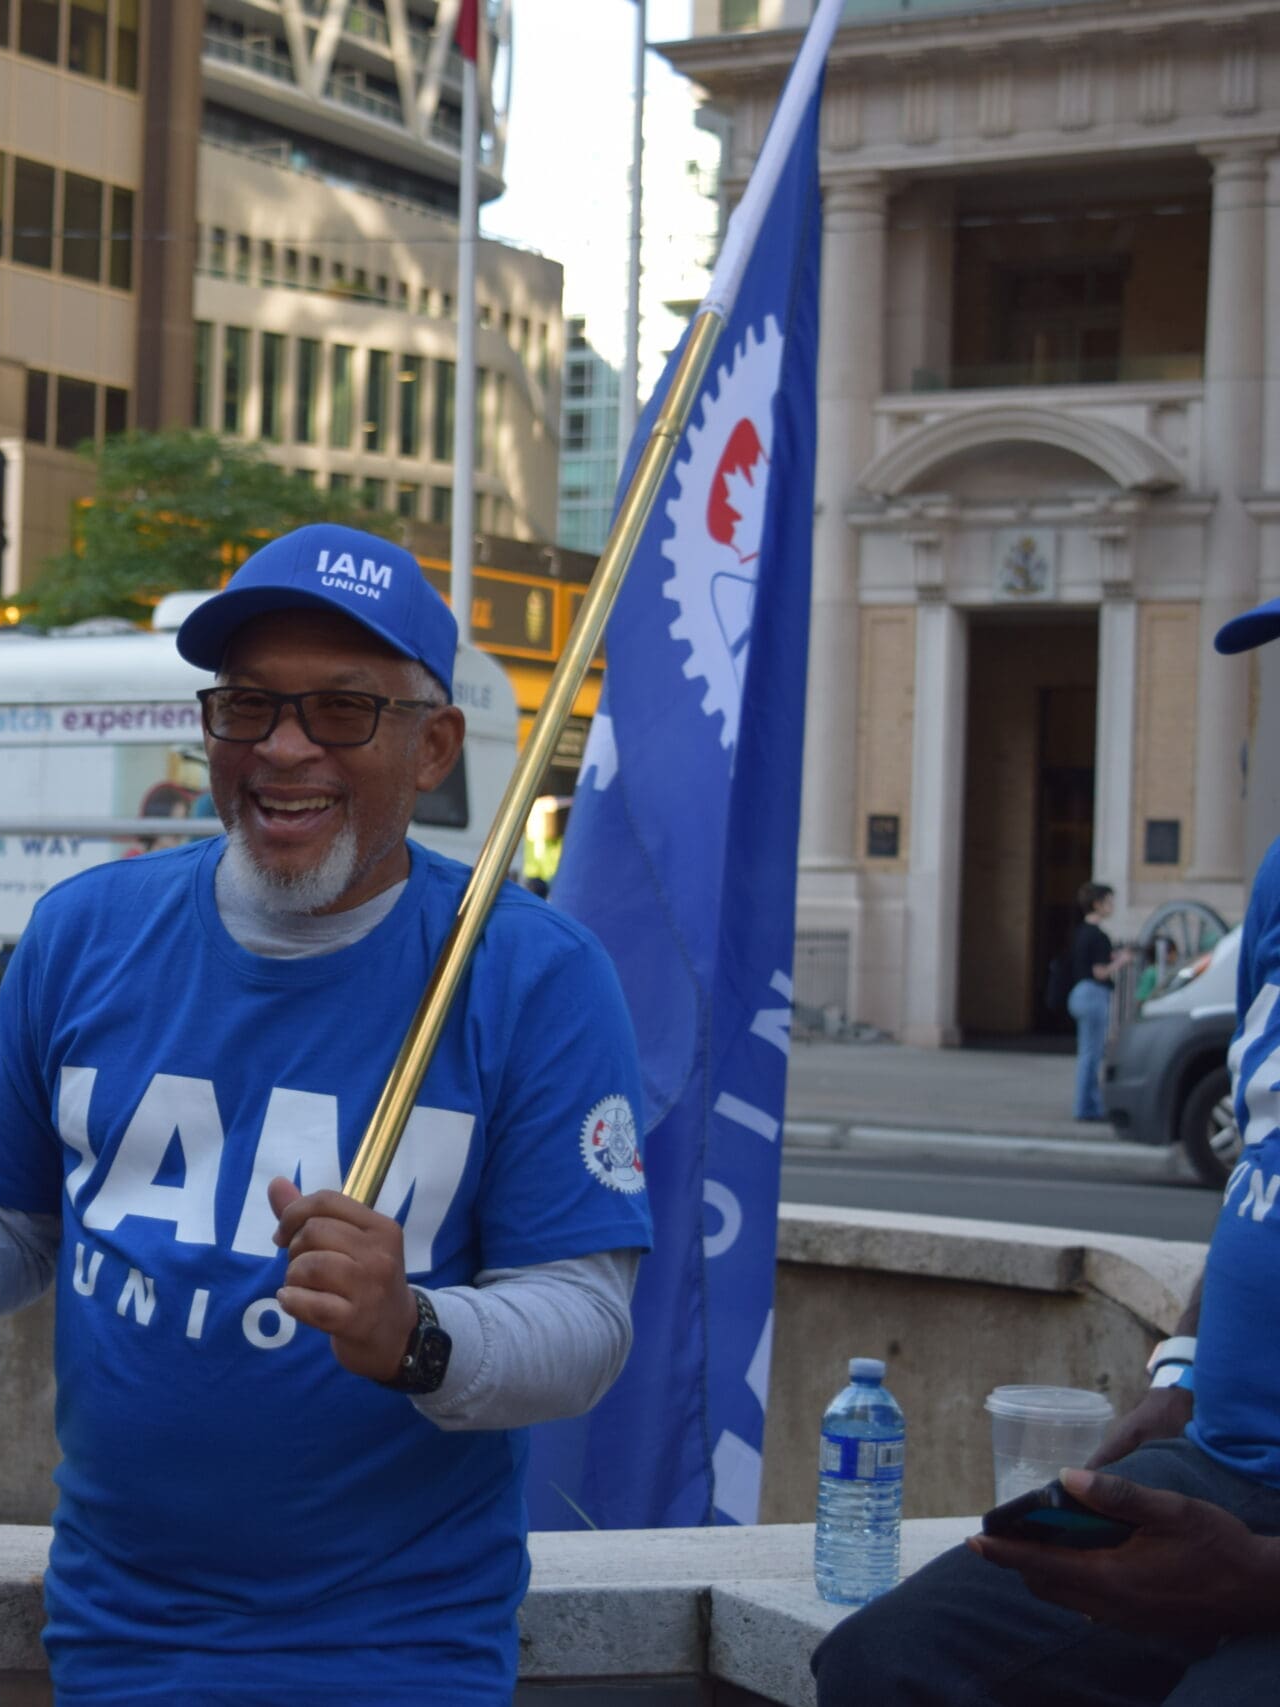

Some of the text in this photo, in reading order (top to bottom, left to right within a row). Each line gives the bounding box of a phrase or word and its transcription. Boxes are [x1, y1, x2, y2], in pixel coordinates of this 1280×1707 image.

[316, 550, 393, 589] IAM
[321, 575, 381, 600] UNION
[62, 705, 202, 736] experien
[21, 834, 82, 856] WAY
[57, 1065, 477, 1275] IAM
[72, 1241, 297, 1350] UNIO
